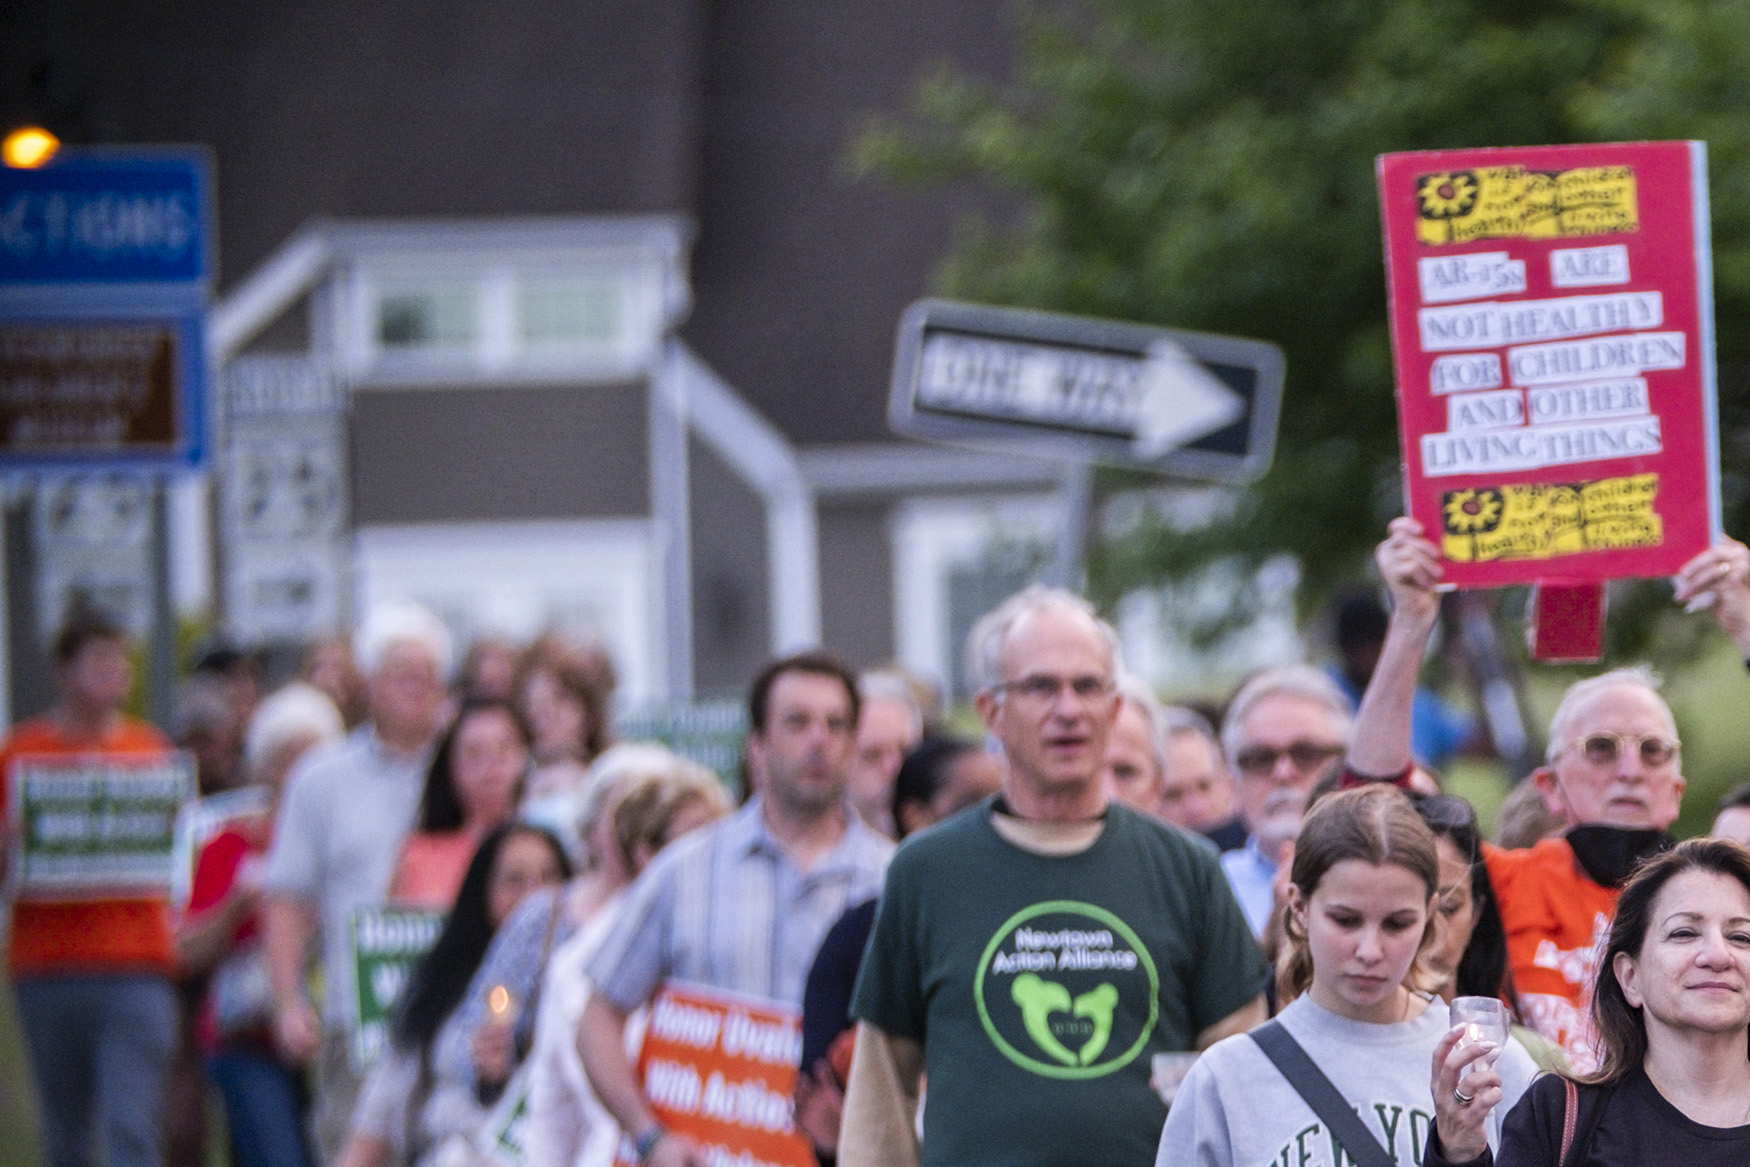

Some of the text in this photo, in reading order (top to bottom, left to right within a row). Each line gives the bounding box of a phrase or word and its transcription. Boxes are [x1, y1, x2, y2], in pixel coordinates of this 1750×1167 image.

[1562, 251, 1621, 278] ARE
[1426, 295, 1652, 342] NOT HEALTHY
[1433, 337, 1683, 390] FOR CHILDREN
[1458, 380, 1643, 426] AND OTHER
[1427, 421, 1661, 467] LIVING THINGS
[992, 947, 1138, 975] Action Alliance
[1015, 927, 1113, 951] Newtown
